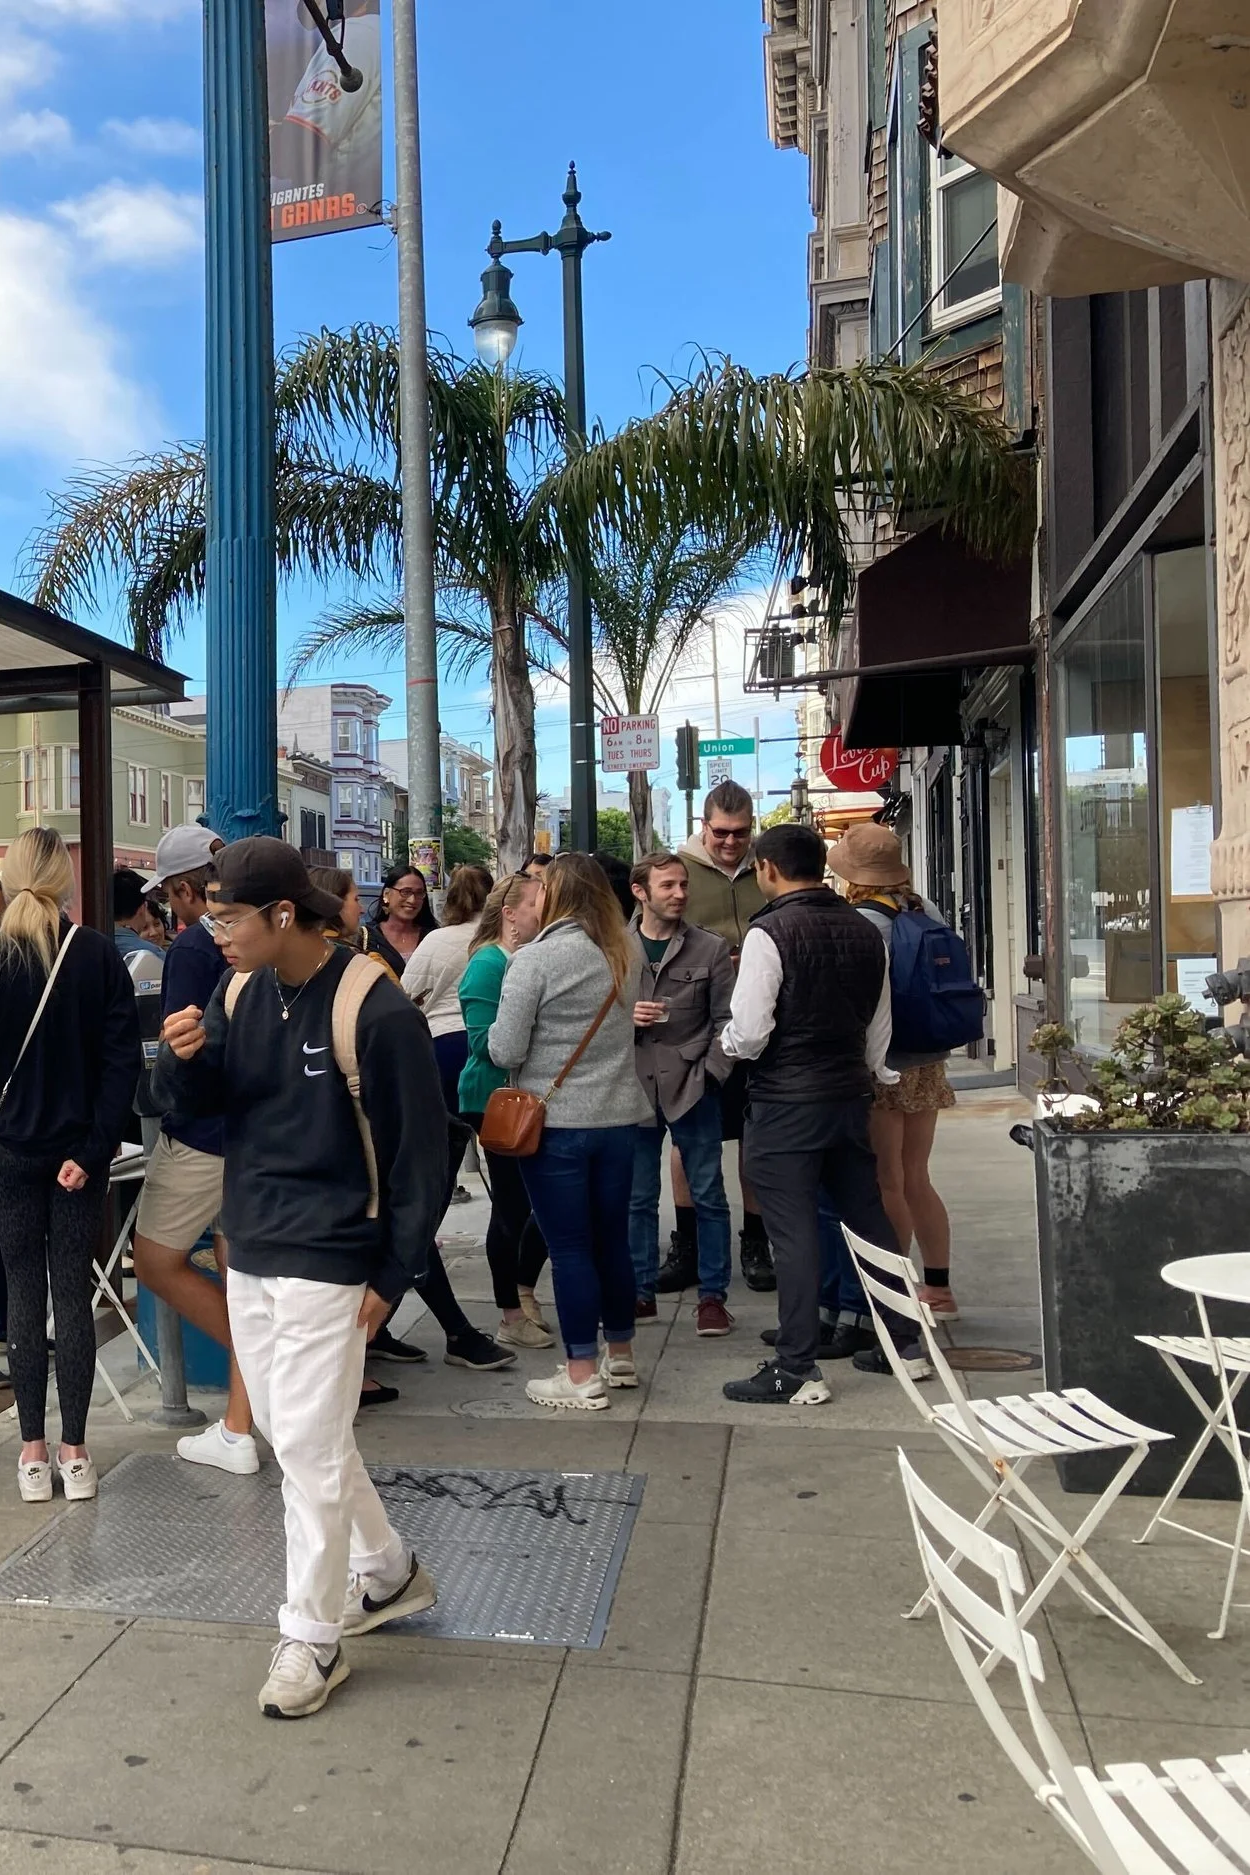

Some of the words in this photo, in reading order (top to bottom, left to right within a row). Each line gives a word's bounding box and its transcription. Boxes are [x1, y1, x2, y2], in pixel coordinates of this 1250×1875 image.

[270, 183, 325, 206] IGANTES
[281, 193, 355, 229] GANAS
[603, 719, 618, 733] NO
[622, 719, 656, 731] PARKING
[608, 751, 624, 760] TUES
[630, 749, 652, 758] THURS
[703, 743, 735, 753] Union
[858, 754, 890, 784] Cup
